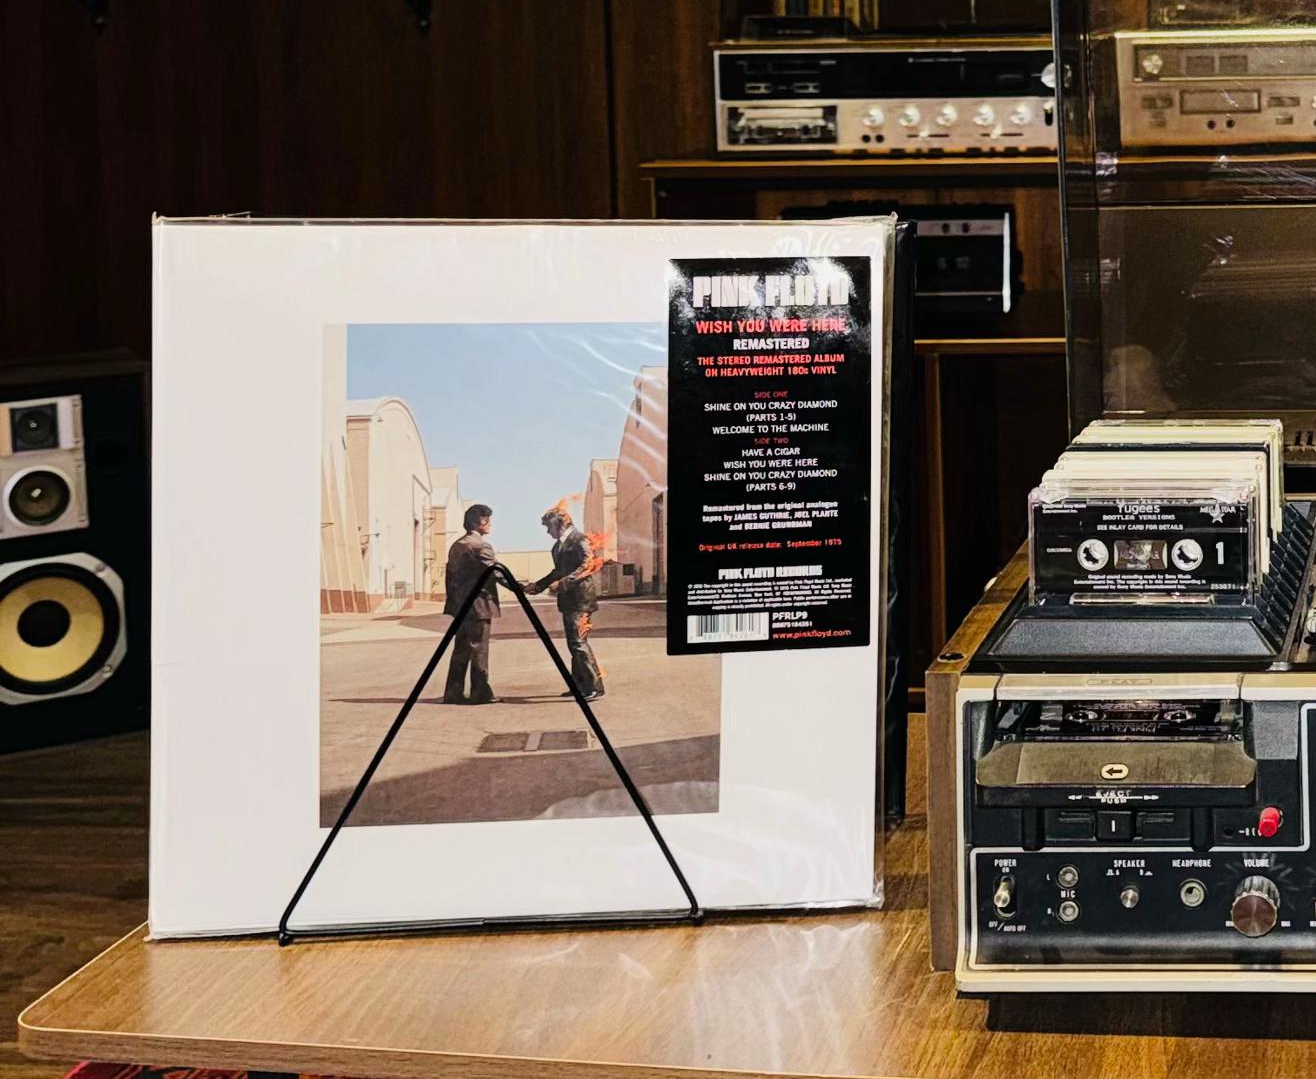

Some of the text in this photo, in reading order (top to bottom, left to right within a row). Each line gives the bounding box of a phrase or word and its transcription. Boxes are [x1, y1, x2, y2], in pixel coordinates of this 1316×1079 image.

[693, 276, 760, 307] PINK
[696, 318, 846, 334] WISH YOU WERE HERE
[733, 338, 810, 351] REMASTERED
[697, 354, 844, 366] THE STEREO REMASTERED ALBUM
[705, 365, 837, 377] ON HEAVYWEIGHT VINYL
[754, 391, 788, 399] SIDE ONE
[704, 400, 838, 412] SHINE ON YOU CRAZY DIAMOND
[746, 412, 797, 423] (PARTS 1-5)
[712, 423, 829, 435] WELCOME TO THE MACHINE
[741, 447, 800, 457] HAVE A CIGAR
[723, 458, 818, 469] WISH YOU WERE HERE
[704, 469, 838, 482] SHINE ON YOU CRAZY DIAMOND
[746, 482, 796, 492] (PARTS 6-9)
[703, 501, 838, 512] Remastered from the original analogue
[698, 544, 725, 552] Original
[739, 542, 764, 550] release
[787, 540, 822, 549] September
[1215, 541, 1225, 565] 1
[994, 858, 1270, 868] POWER SPEAKER HEADPHONE VOLUME
